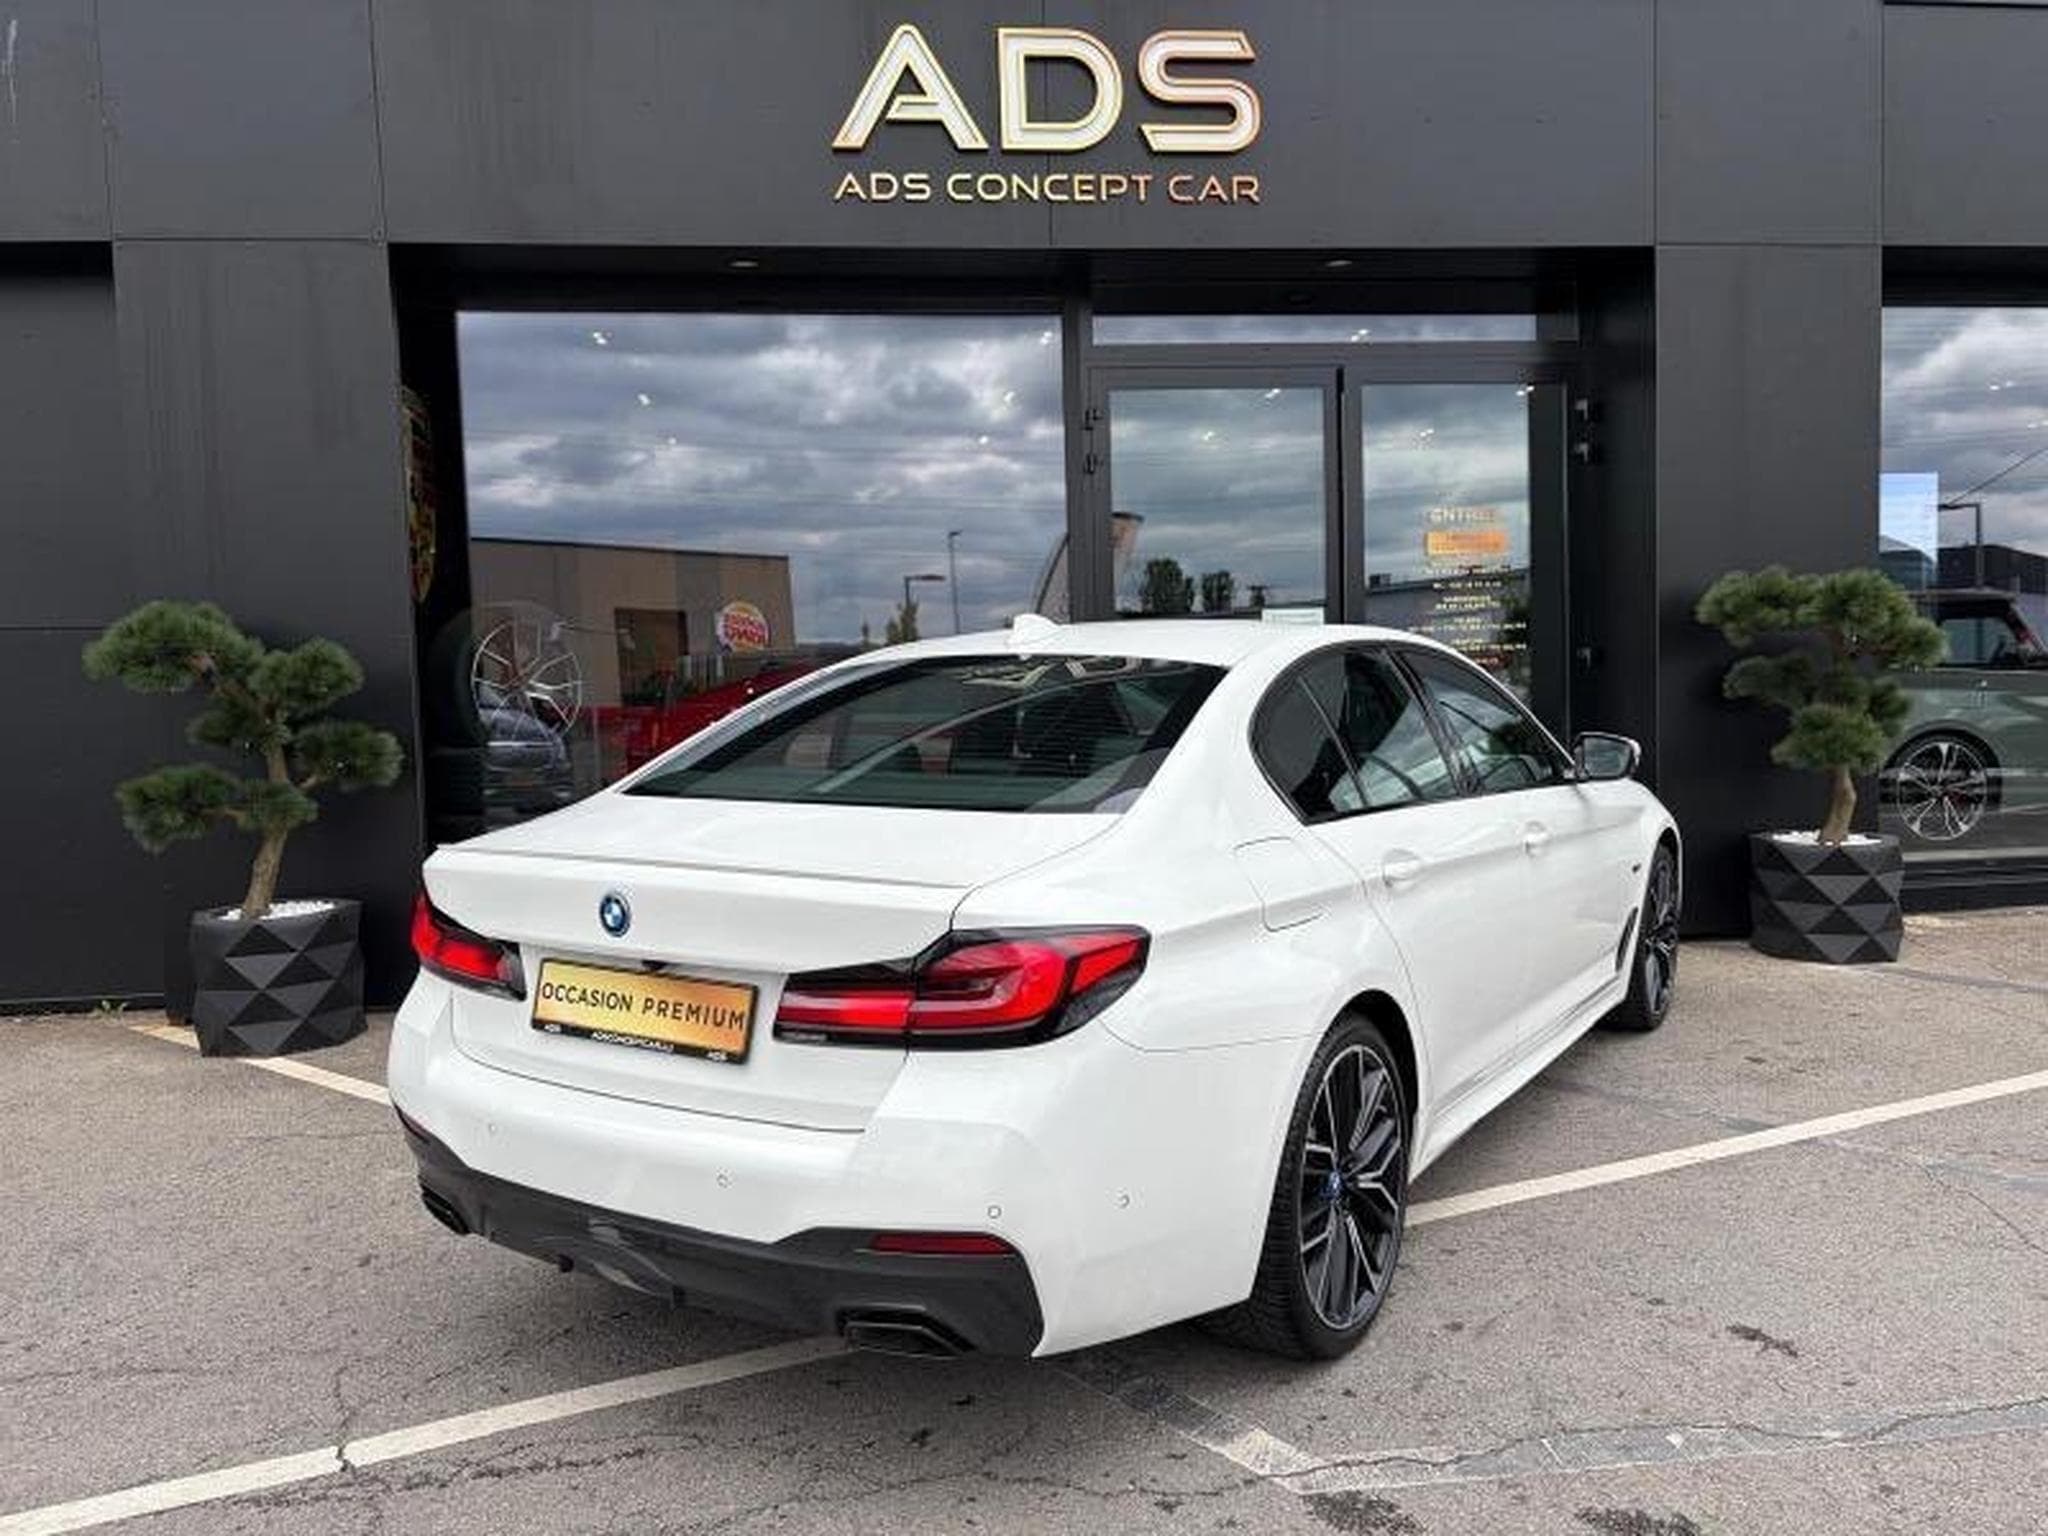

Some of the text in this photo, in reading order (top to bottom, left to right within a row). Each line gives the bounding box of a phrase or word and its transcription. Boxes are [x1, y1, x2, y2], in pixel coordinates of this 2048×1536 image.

[832, 23, 1262, 152] ADS
[834, 173, 1260, 204] ADS CONCEPT CAR
[541, 982, 745, 1030] OCCASION PREMIUM
